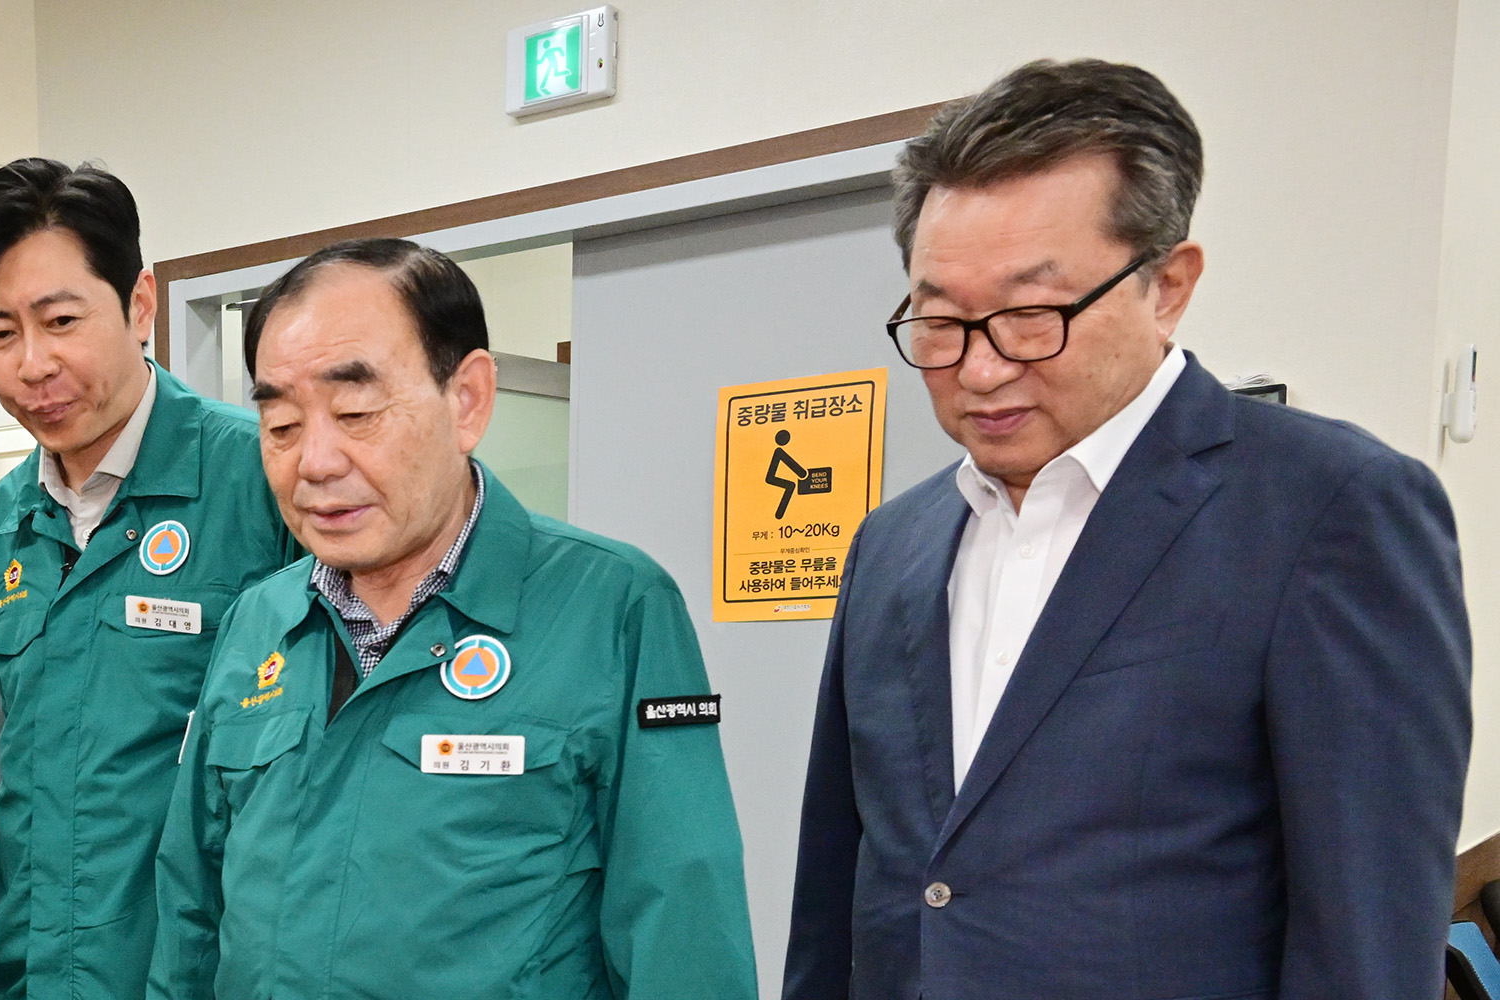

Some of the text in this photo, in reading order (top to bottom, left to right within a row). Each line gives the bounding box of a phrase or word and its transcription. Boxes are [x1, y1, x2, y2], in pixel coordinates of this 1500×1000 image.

[737, 394, 863, 426] 중량물 취급장소
[752, 531, 768, 540] 무게
[779, 523, 840, 539] 10~20Kg
[749, 557, 837, 575] 중량물은 무릎을
[739, 578, 786, 593] 사용하여
[152, 604, 190, 614] 울산광역시의회
[645, 702, 718, 719] 울산광역시 의회
[457, 742, 510, 751] 울산광역시의회
